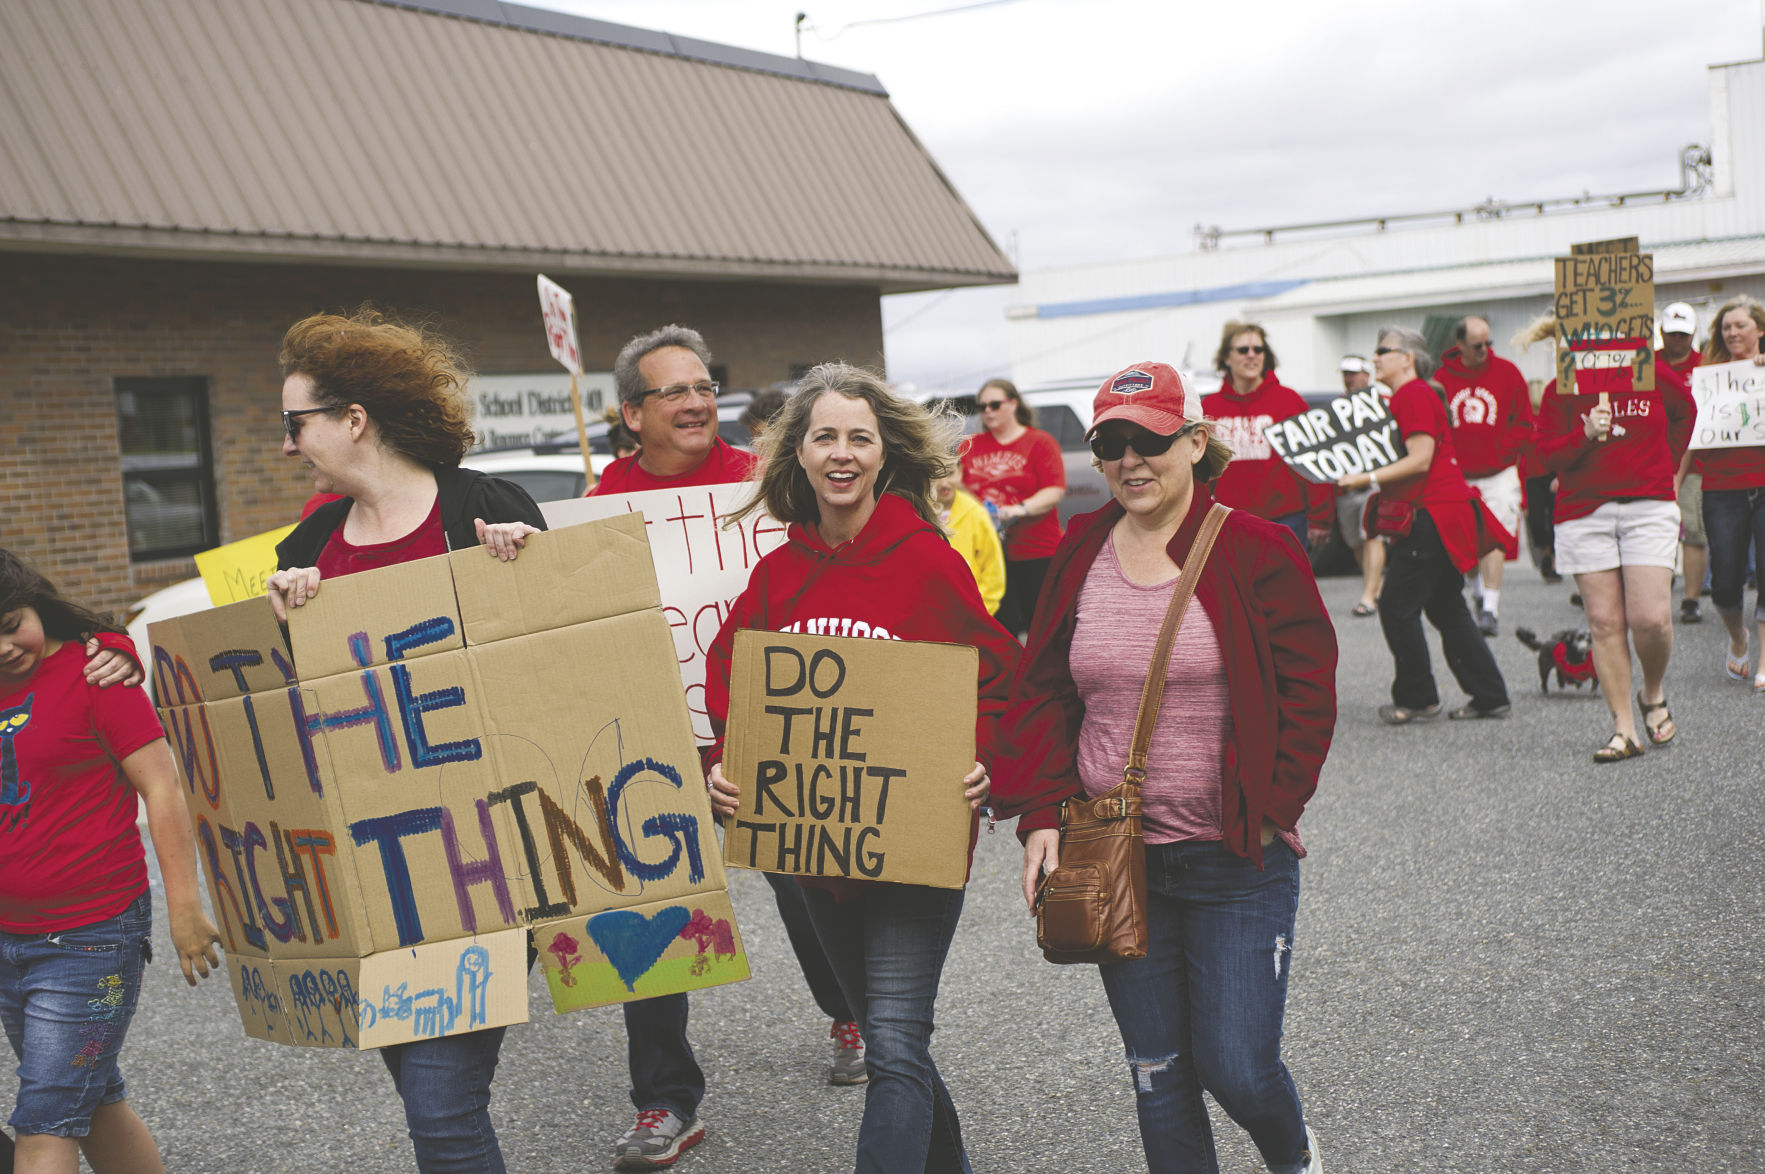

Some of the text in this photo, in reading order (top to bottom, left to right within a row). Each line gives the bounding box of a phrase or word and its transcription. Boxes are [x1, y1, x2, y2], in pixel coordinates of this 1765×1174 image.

[1555, 254, 1653, 289] TEACHERS
[1555, 287, 1595, 320] GET
[1559, 313, 1655, 349] WHO GETS
[479, 391, 522, 418] School
[1263, 408, 1337, 457] FAIR
[1331, 386, 1387, 432] PAY
[666, 492, 787, 574] the
[764, 645, 846, 699] DO
[208, 615, 483, 801] THE
[764, 704, 874, 762] THE
[754, 759, 907, 825] RIGHT
[196, 756, 705, 953] RIGHT THING
[736, 819, 886, 878] THING
